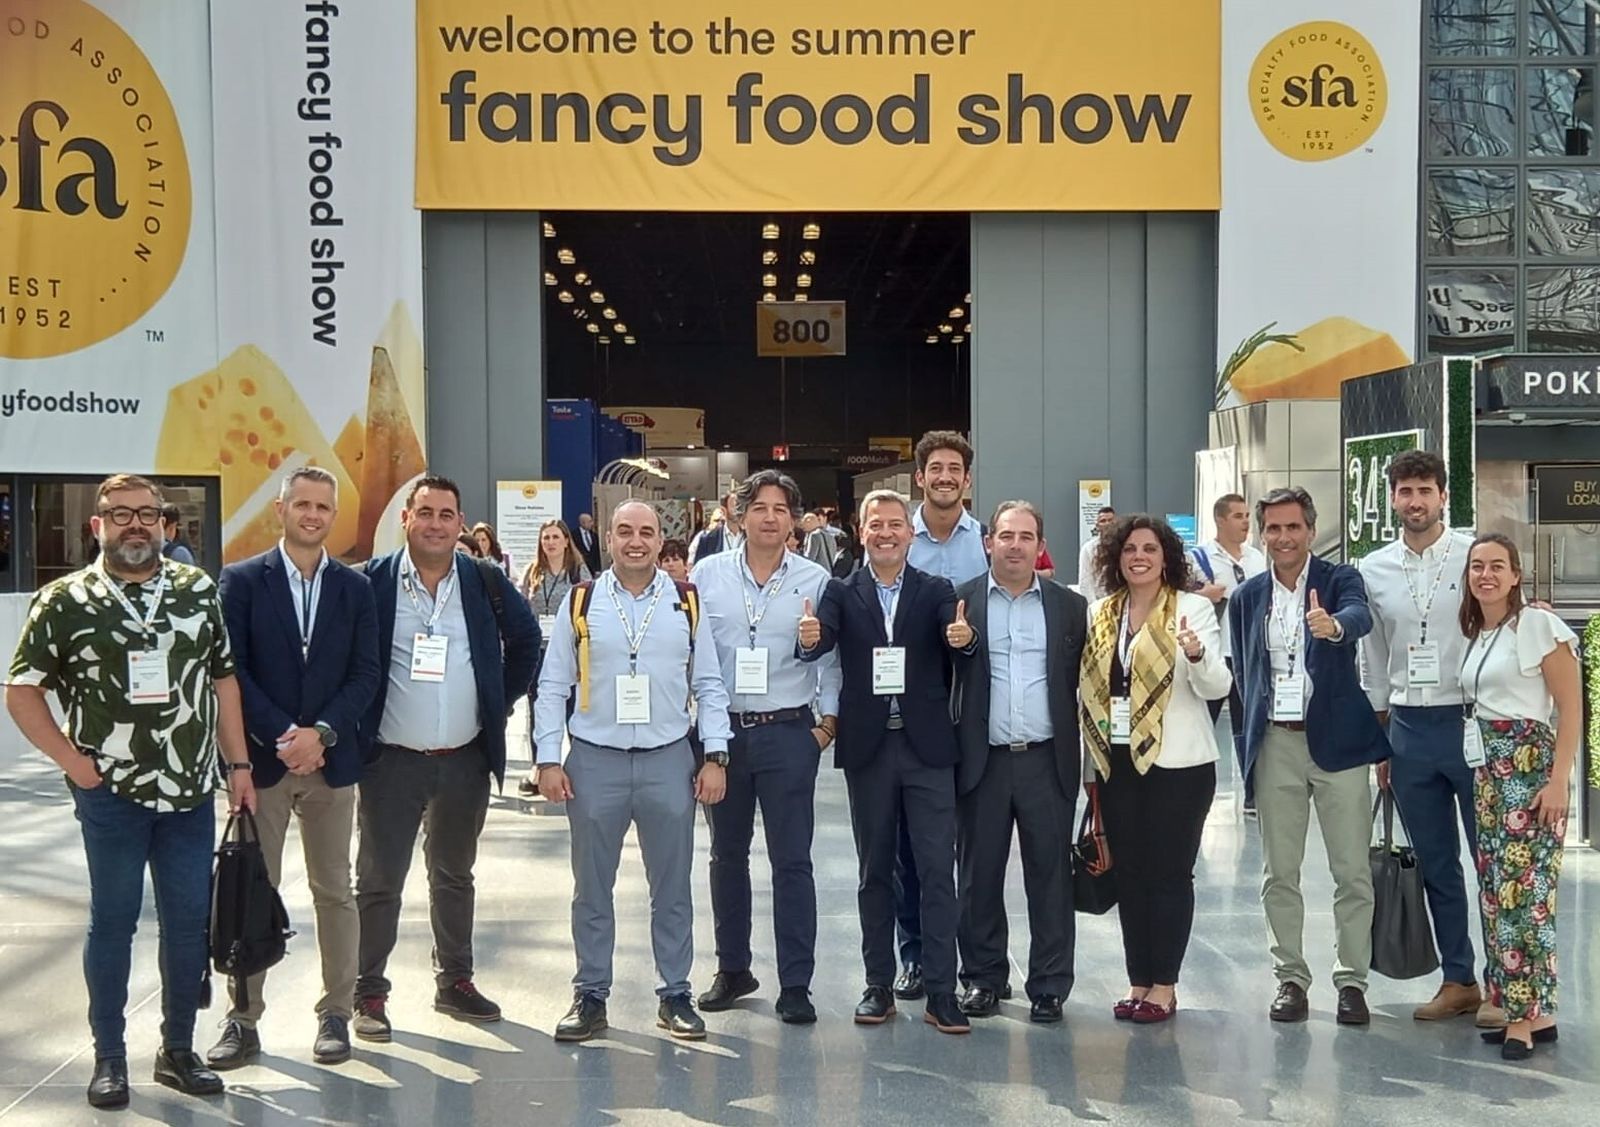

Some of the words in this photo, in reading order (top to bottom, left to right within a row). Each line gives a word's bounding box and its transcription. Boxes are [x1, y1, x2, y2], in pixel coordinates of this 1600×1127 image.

[439, 14, 638, 53] welcome
[649, 21, 694, 54] to
[705, 17, 775, 54] the
[791, 28, 976, 55] summer
[297, 0, 339, 121] fancy
[1260, 48, 1285, 122] SPECIALTY
[1289, 33, 1328, 48] FOOD
[1335, 37, 1376, 123] ASSOCIATION
[1280, 63, 1359, 108] sfa
[440, 70, 702, 167] fancy
[727, 72, 931, 145] food
[957, 73, 1193, 145] show
[1306, 130, 1330, 139] EST
[0, 100, 129, 219] fa
[70, 37, 165, 263] ASSOCIATION
[1302, 142, 1334, 150] 1952
[308, 132, 344, 226] food
[9, 276, 61, 298] EST
[310, 238, 345, 347] show
[0, 306, 71, 329] 1952
[145, 330, 164, 342] TM
[773, 319, 830, 344] 800
[2, 388, 140, 417] yfoodshow
[1348, 455, 1404, 542] 341
[1574, 480, 1597, 492] BUY
